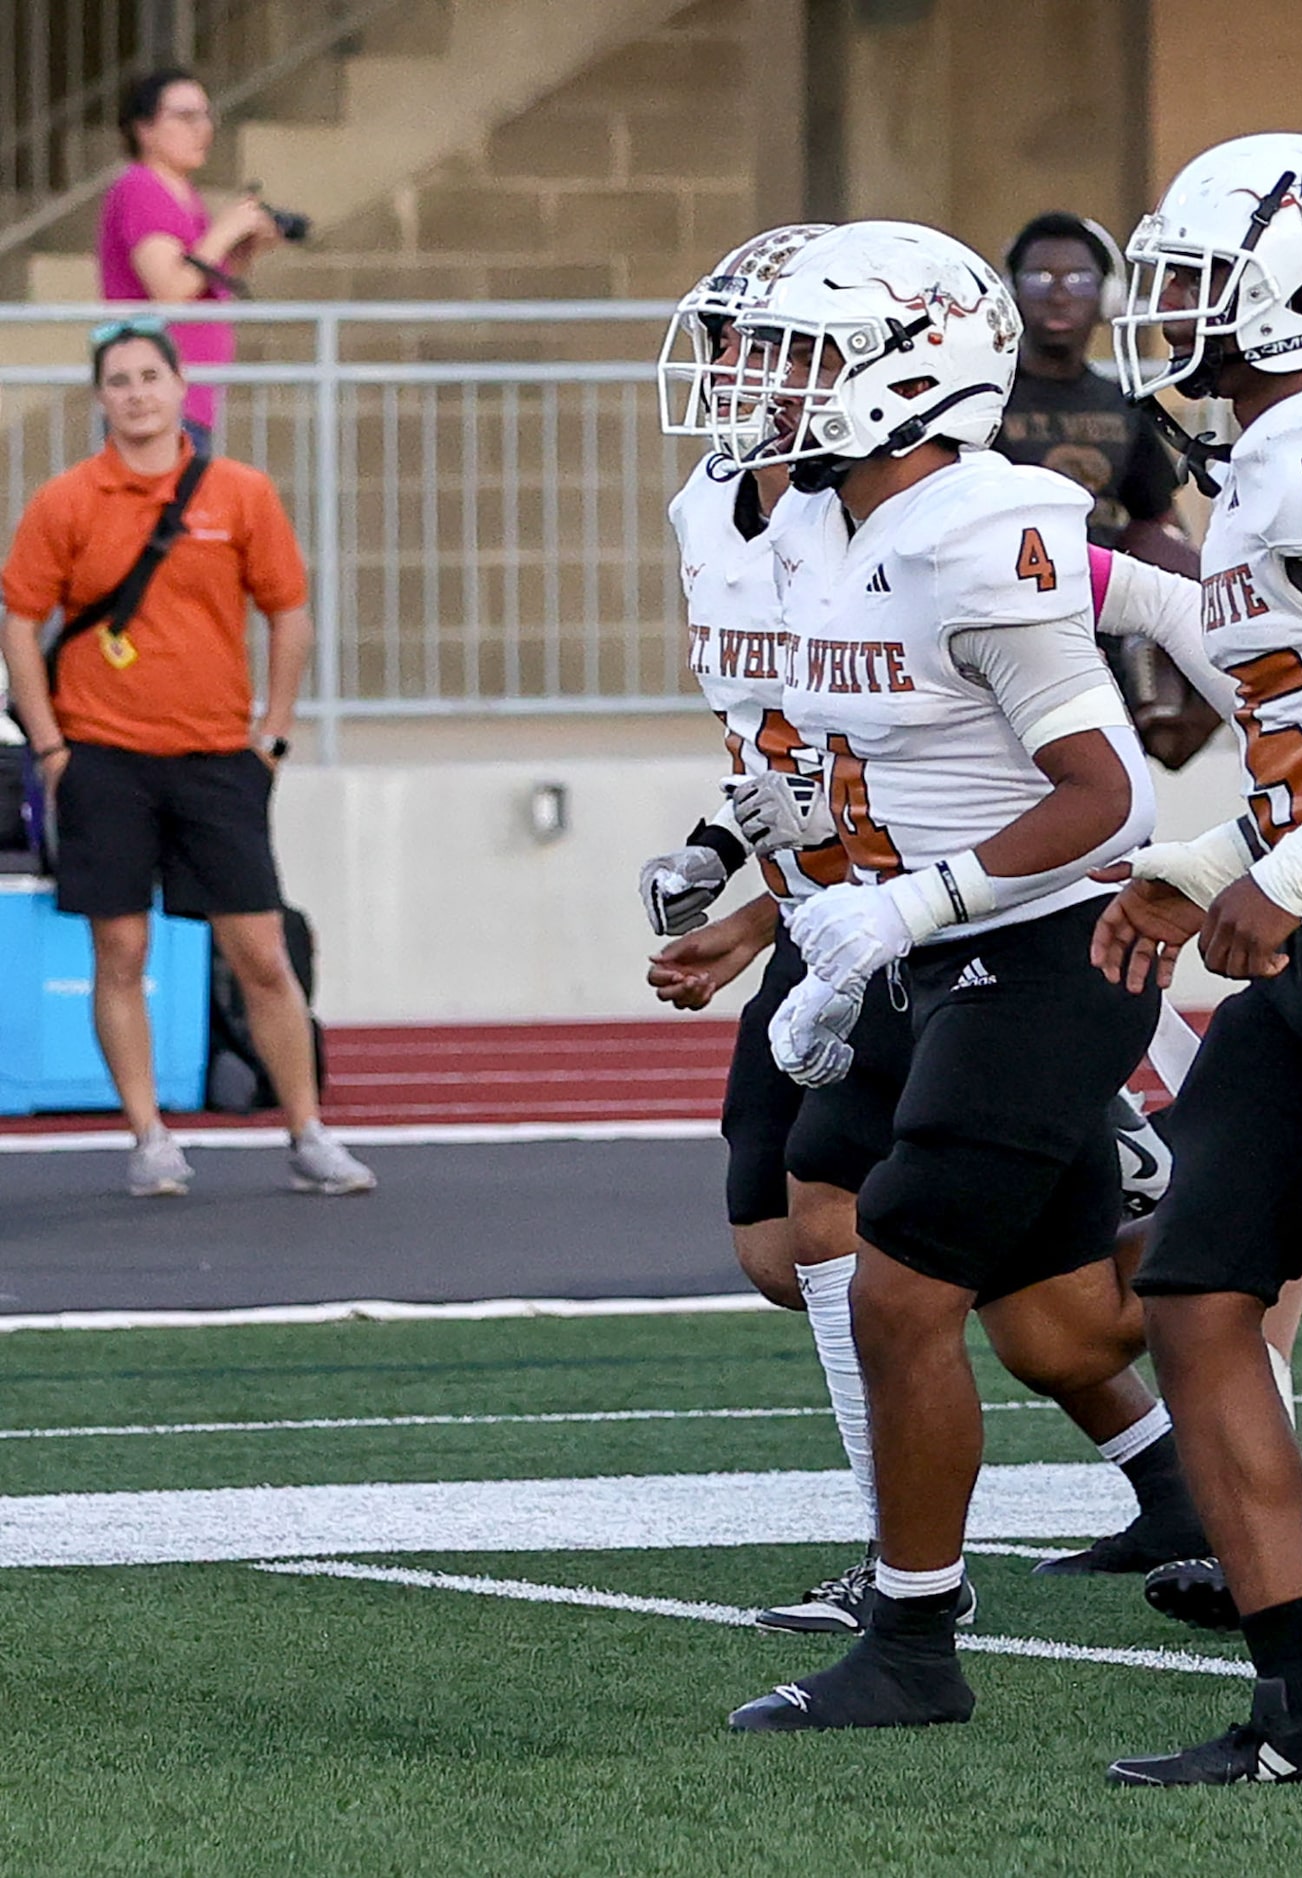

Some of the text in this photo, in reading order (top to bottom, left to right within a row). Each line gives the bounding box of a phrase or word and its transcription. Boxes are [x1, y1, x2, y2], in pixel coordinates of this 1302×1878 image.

[1015, 527, 1057, 593] 4
[1201, 563, 1270, 634] HITE
[806, 637, 916, 693] WHITE
